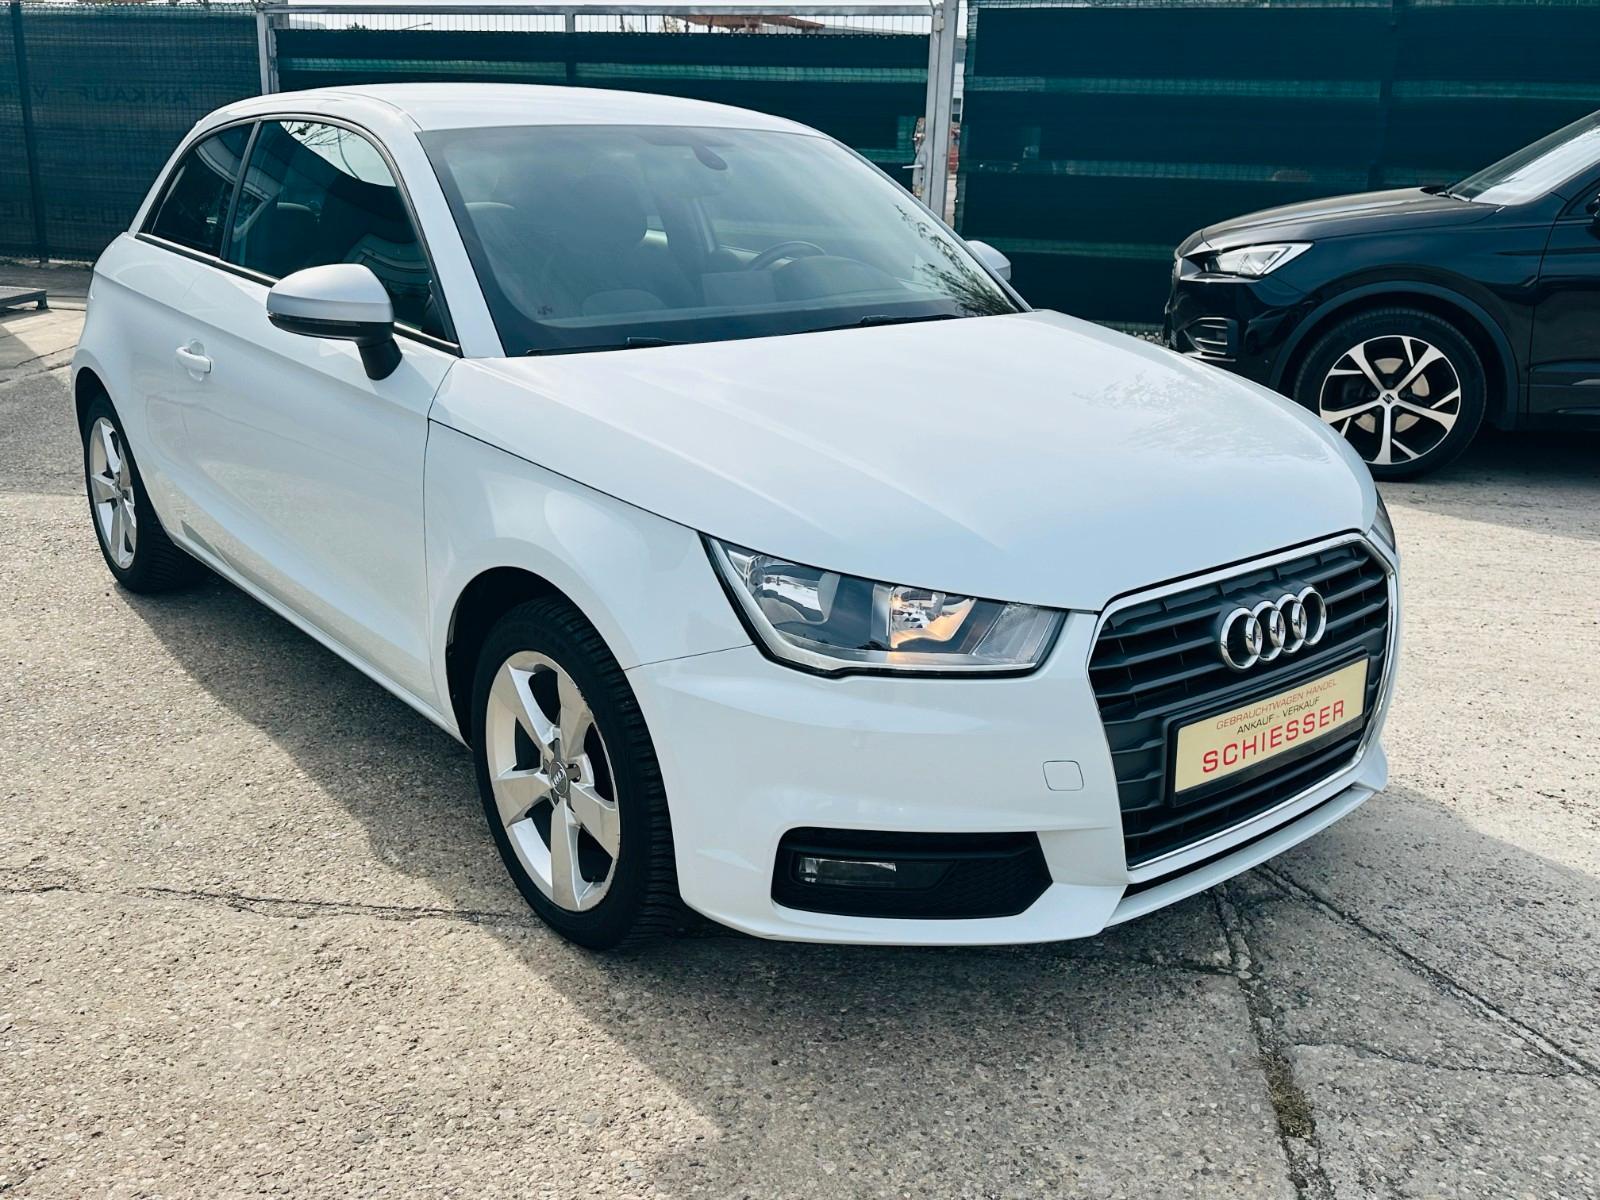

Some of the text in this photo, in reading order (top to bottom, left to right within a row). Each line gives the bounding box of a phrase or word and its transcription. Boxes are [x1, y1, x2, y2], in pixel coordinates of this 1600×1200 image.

[1216, 679, 1337, 730] GEBRAUCHTWAGEN HANDEL
[1237, 713, 1275, 735] ANKAUF
[1282, 696, 1320, 718] VERKAUF
[1202, 700, 1345, 774] SCHIESSER
